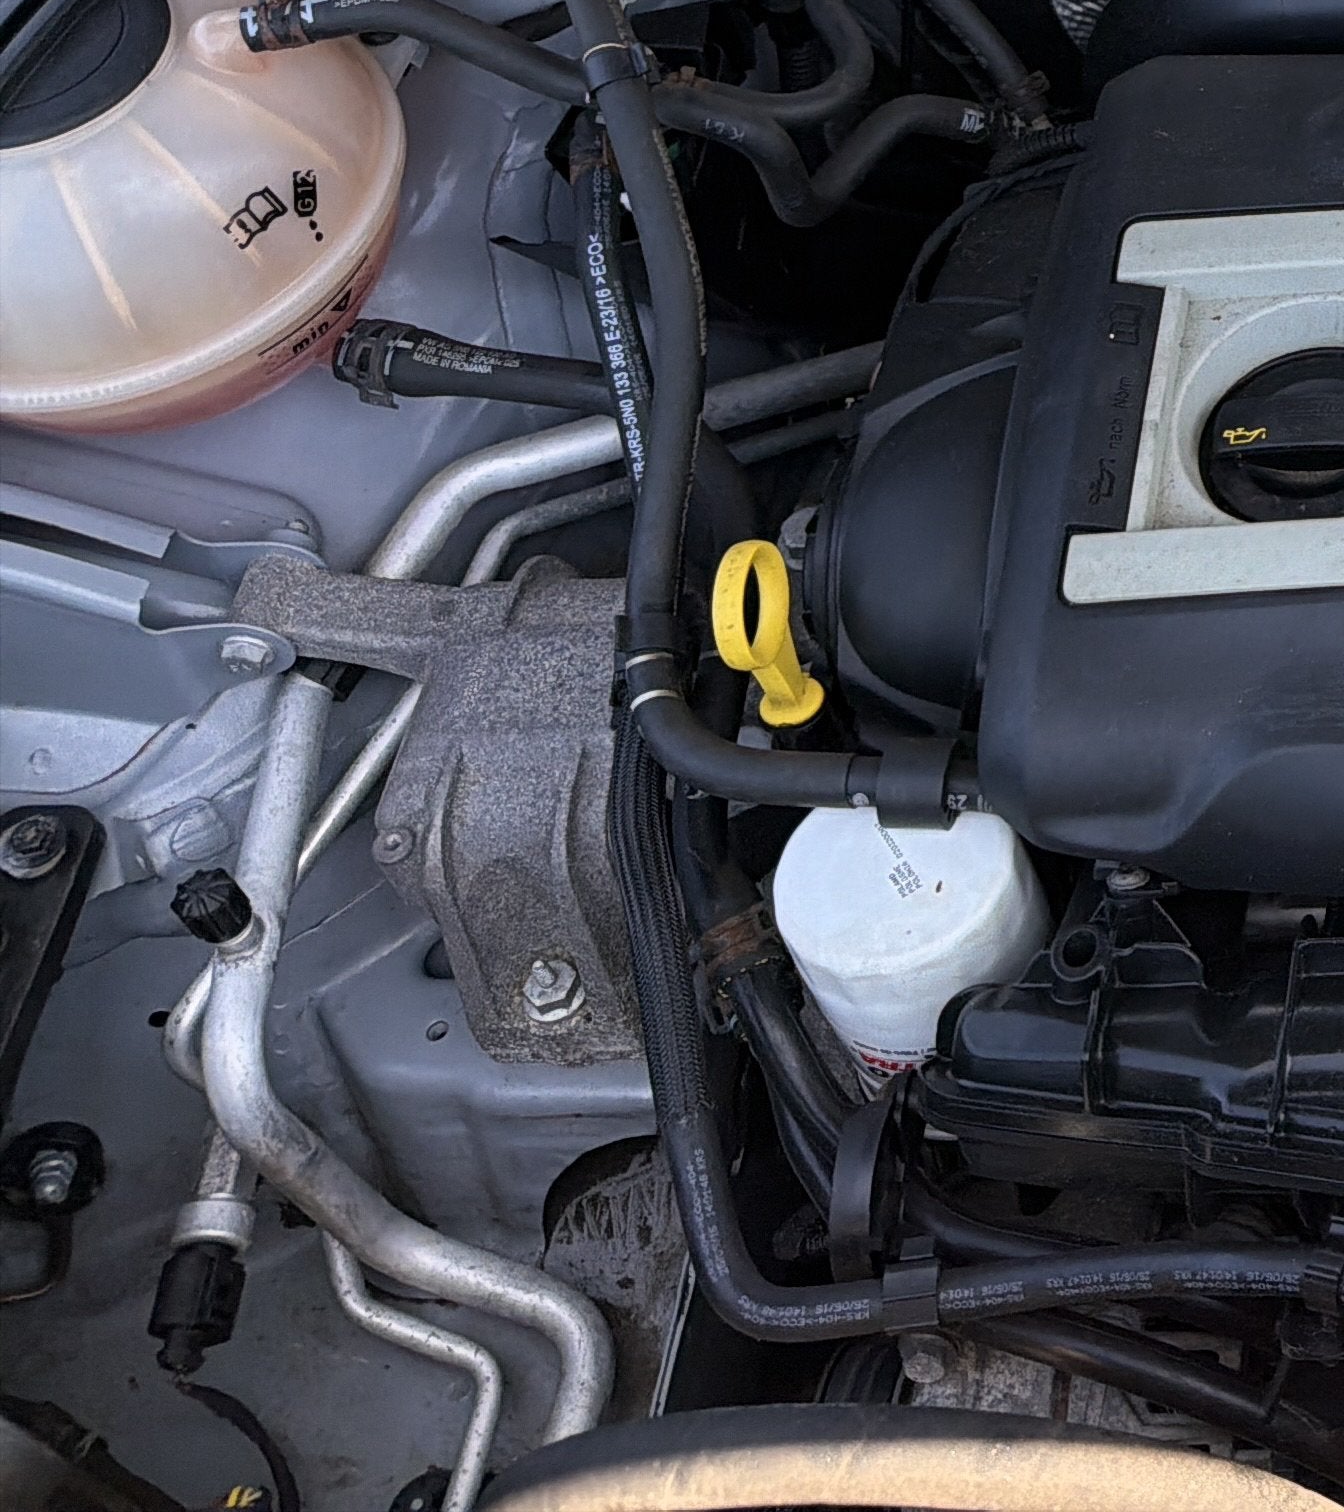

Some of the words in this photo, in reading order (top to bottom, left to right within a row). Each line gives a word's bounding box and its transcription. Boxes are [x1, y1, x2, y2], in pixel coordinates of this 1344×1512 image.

[588, 232, 607, 286] >ECO<
[595, 288, 621, 342] E-23/16
[293, 321, 329, 356] min
[412, 351, 439, 366] MADE
[440, 357, 451, 368] IN
[451, 359, 493, 374] ROMANIA
[613, 372, 631, 396] 133
[1109, 418, 1123, 449] nach
